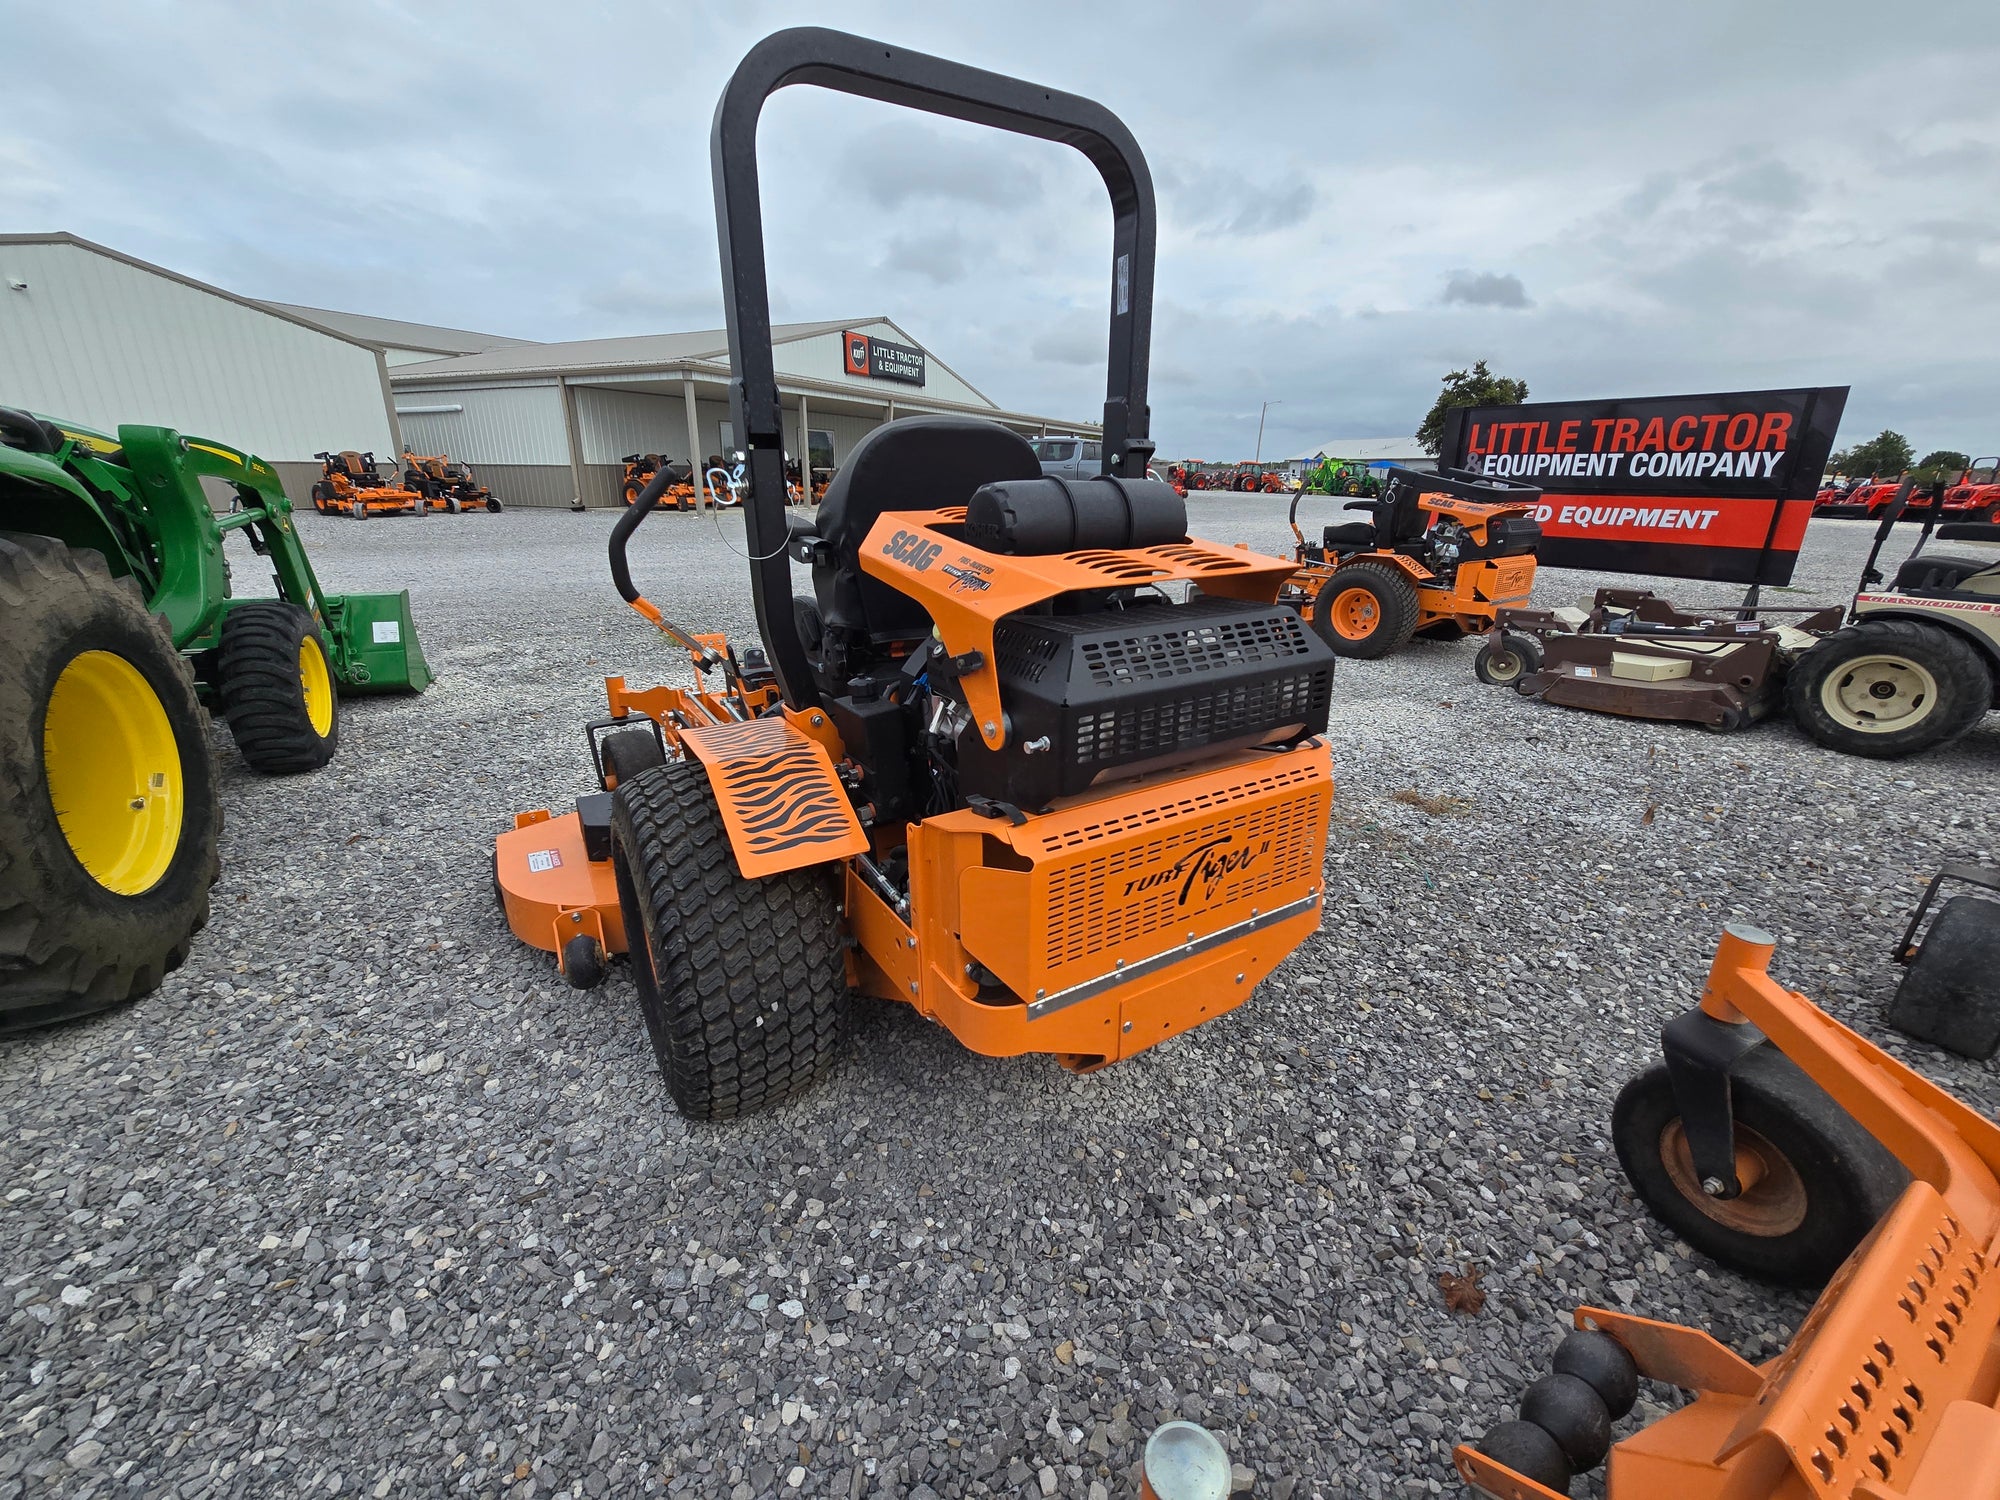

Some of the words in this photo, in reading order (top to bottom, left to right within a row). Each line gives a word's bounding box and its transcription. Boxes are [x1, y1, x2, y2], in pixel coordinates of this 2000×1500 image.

[873, 345, 895, 359] LITTLE
[896, 351, 923, 366] TRACTOR
[878, 360, 884, 370] &
[885, 363, 919, 378] EQUIPMENT
[1469, 420, 1582, 454] LITTLE
[1591, 412, 1793, 453] TRACTOR
[1483, 452, 1624, 477] EQUIPMENT
[1630, 451, 1785, 478] COMPANY
[1428, 497, 1456, 508] SCAG
[1558, 505, 1719, 530] EQUIPMENT
[964, 522, 1000, 539] KOHLER
[882, 530, 943, 572] SCAG
[1869, 596, 1985, 611] GRASSHOPPER
[1123, 862, 1188, 897] TURF
[1178, 835, 1257, 906] Tiger
